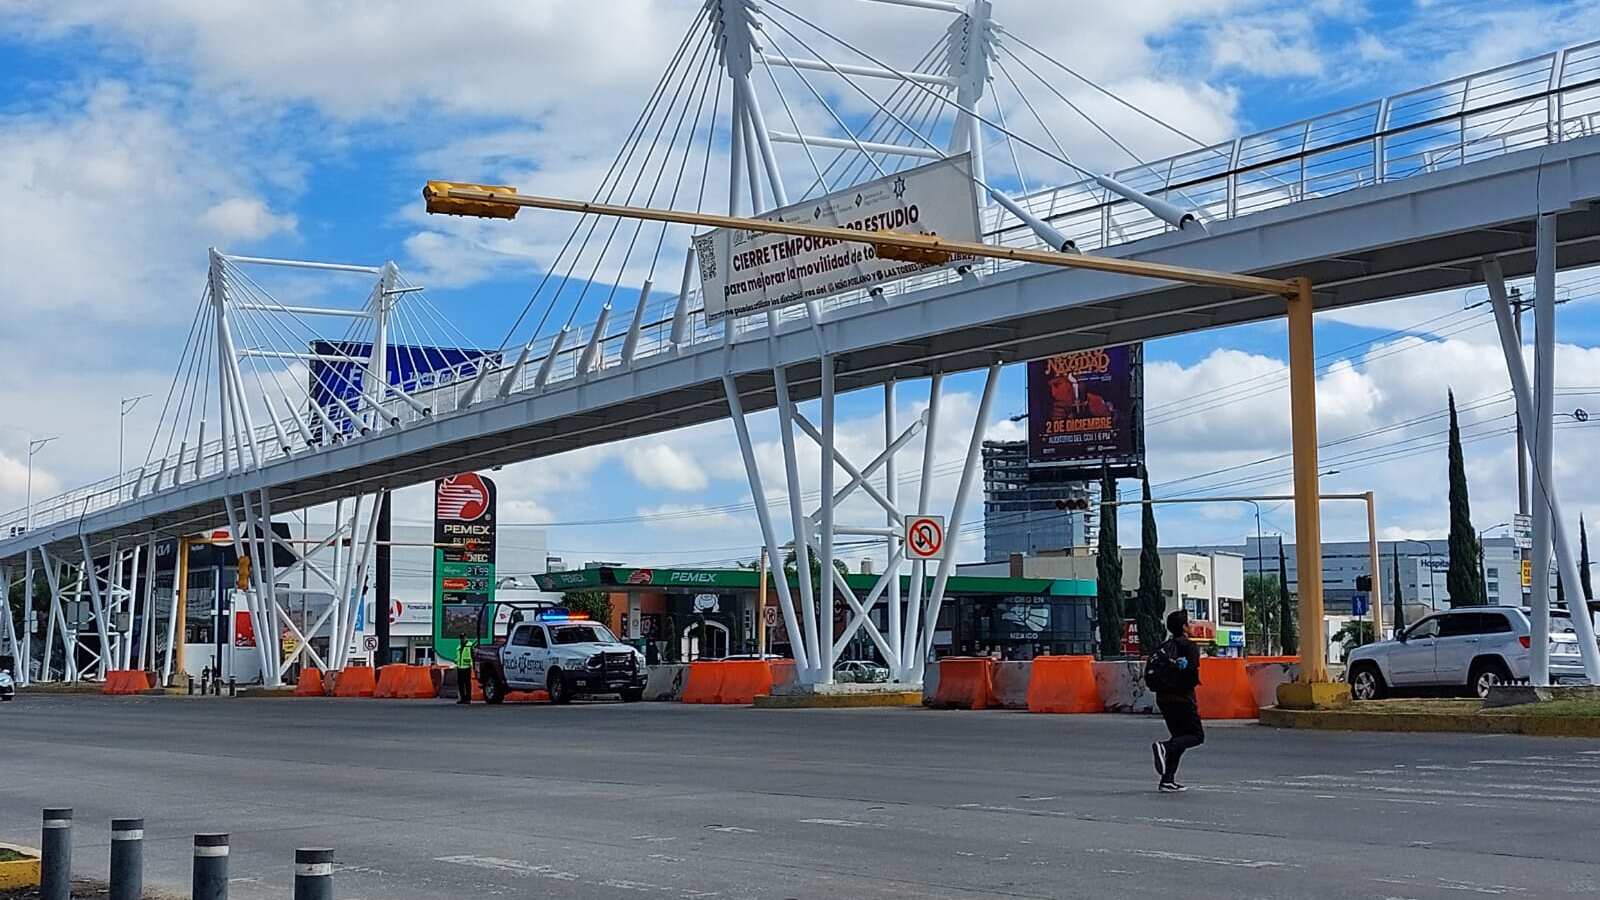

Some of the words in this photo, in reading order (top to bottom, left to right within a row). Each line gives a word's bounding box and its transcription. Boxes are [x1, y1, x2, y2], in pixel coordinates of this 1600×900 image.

[733, 244, 771, 272] CIERRE
[771, 235, 838, 261] TEMPORAL
[864, 204, 919, 232] ESTUDIO
[724, 282, 747, 302] para
[747, 270, 786, 293] mejorar
[786, 267, 797, 281] la
[796, 249, 849, 278] movilidad
[851, 247, 862, 267] de
[883, 268, 897, 278] LAS
[1046, 421, 1053, 433] 2
[1054, 420, 1065, 432] DE
[1066, 416, 1112, 430] DICIEMBRE
[443, 524, 491, 535] PEMEX
[670, 571, 718, 583] PEMEX
